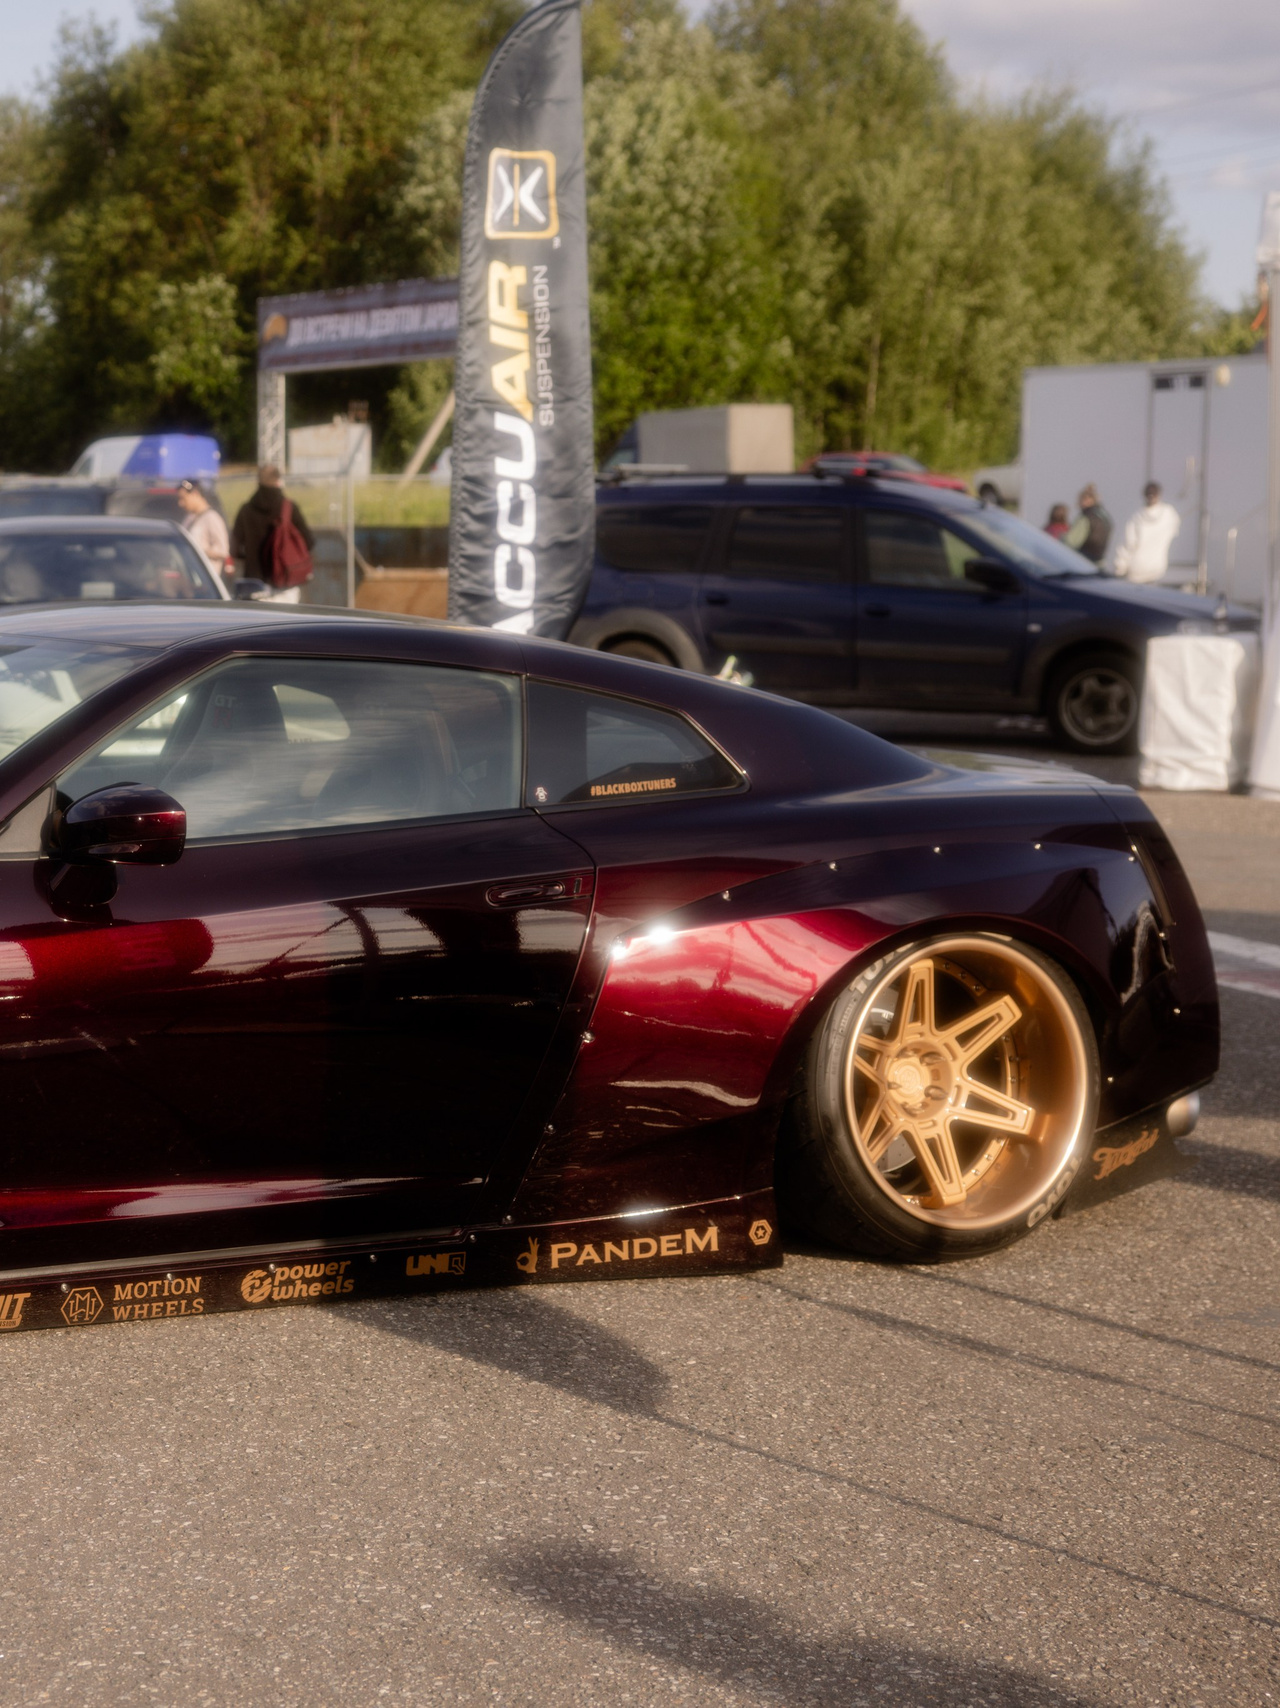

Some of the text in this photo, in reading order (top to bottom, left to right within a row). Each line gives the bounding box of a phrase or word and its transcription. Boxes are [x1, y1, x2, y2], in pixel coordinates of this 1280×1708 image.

[532, 264, 555, 427] SUSPENSION
[590, 777, 677, 797] #BLACKBOXTUNERS
[550, 1226, 719, 1269] PANDEM
[274, 1260, 352, 1287] power
[113, 1276, 202, 1301] MOTION
[271, 1278, 355, 1301] wheels
[112, 1297, 205, 1321] WHEELS
